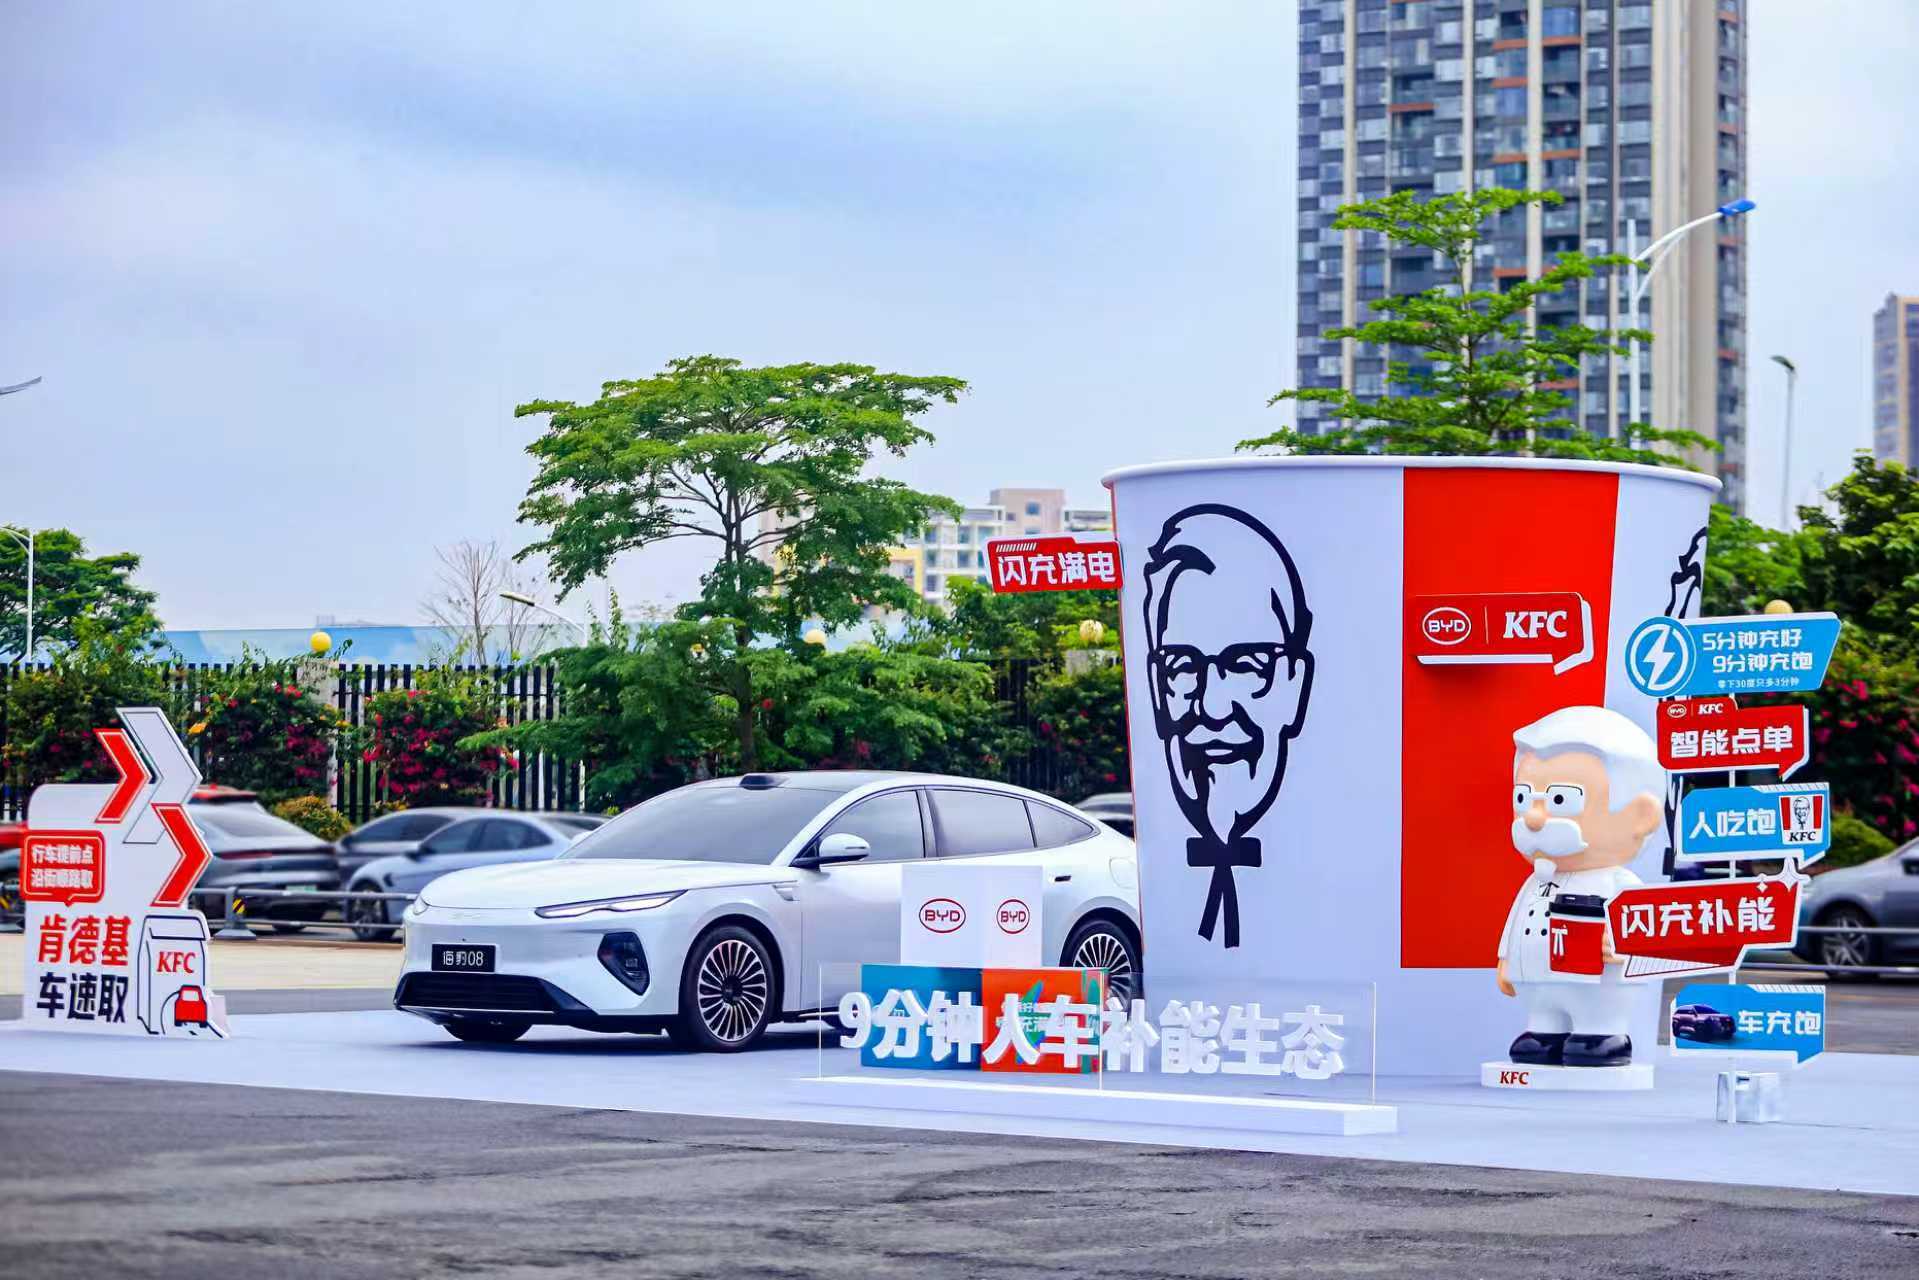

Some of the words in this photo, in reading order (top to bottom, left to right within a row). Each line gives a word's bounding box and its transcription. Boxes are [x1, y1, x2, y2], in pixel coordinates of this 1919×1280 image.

[997, 551, 1116, 587] 闪充满电
[1503, 610, 1567, 638] KFC
[1703, 628, 1802, 651] 5分钟充好
[1712, 651, 1813, 673] 9分钟充饱
[1698, 703, 1724, 715] KFC
[1670, 725, 1793, 758] 智能点单
[1689, 808, 1776, 839] 人吃饱
[1788, 831, 1816, 842] KFC
[1621, 896, 1776, 938] 闪充补能
[38, 914, 133, 967] 肯德基
[156, 951, 197, 974] KFC
[37, 971, 129, 1023] 车速取
[838, 989, 1344, 1080] 9分钟人车补能生态
[1737, 1010, 1821, 1036] 车充饱
[1500, 1071, 1529, 1085] KFC
